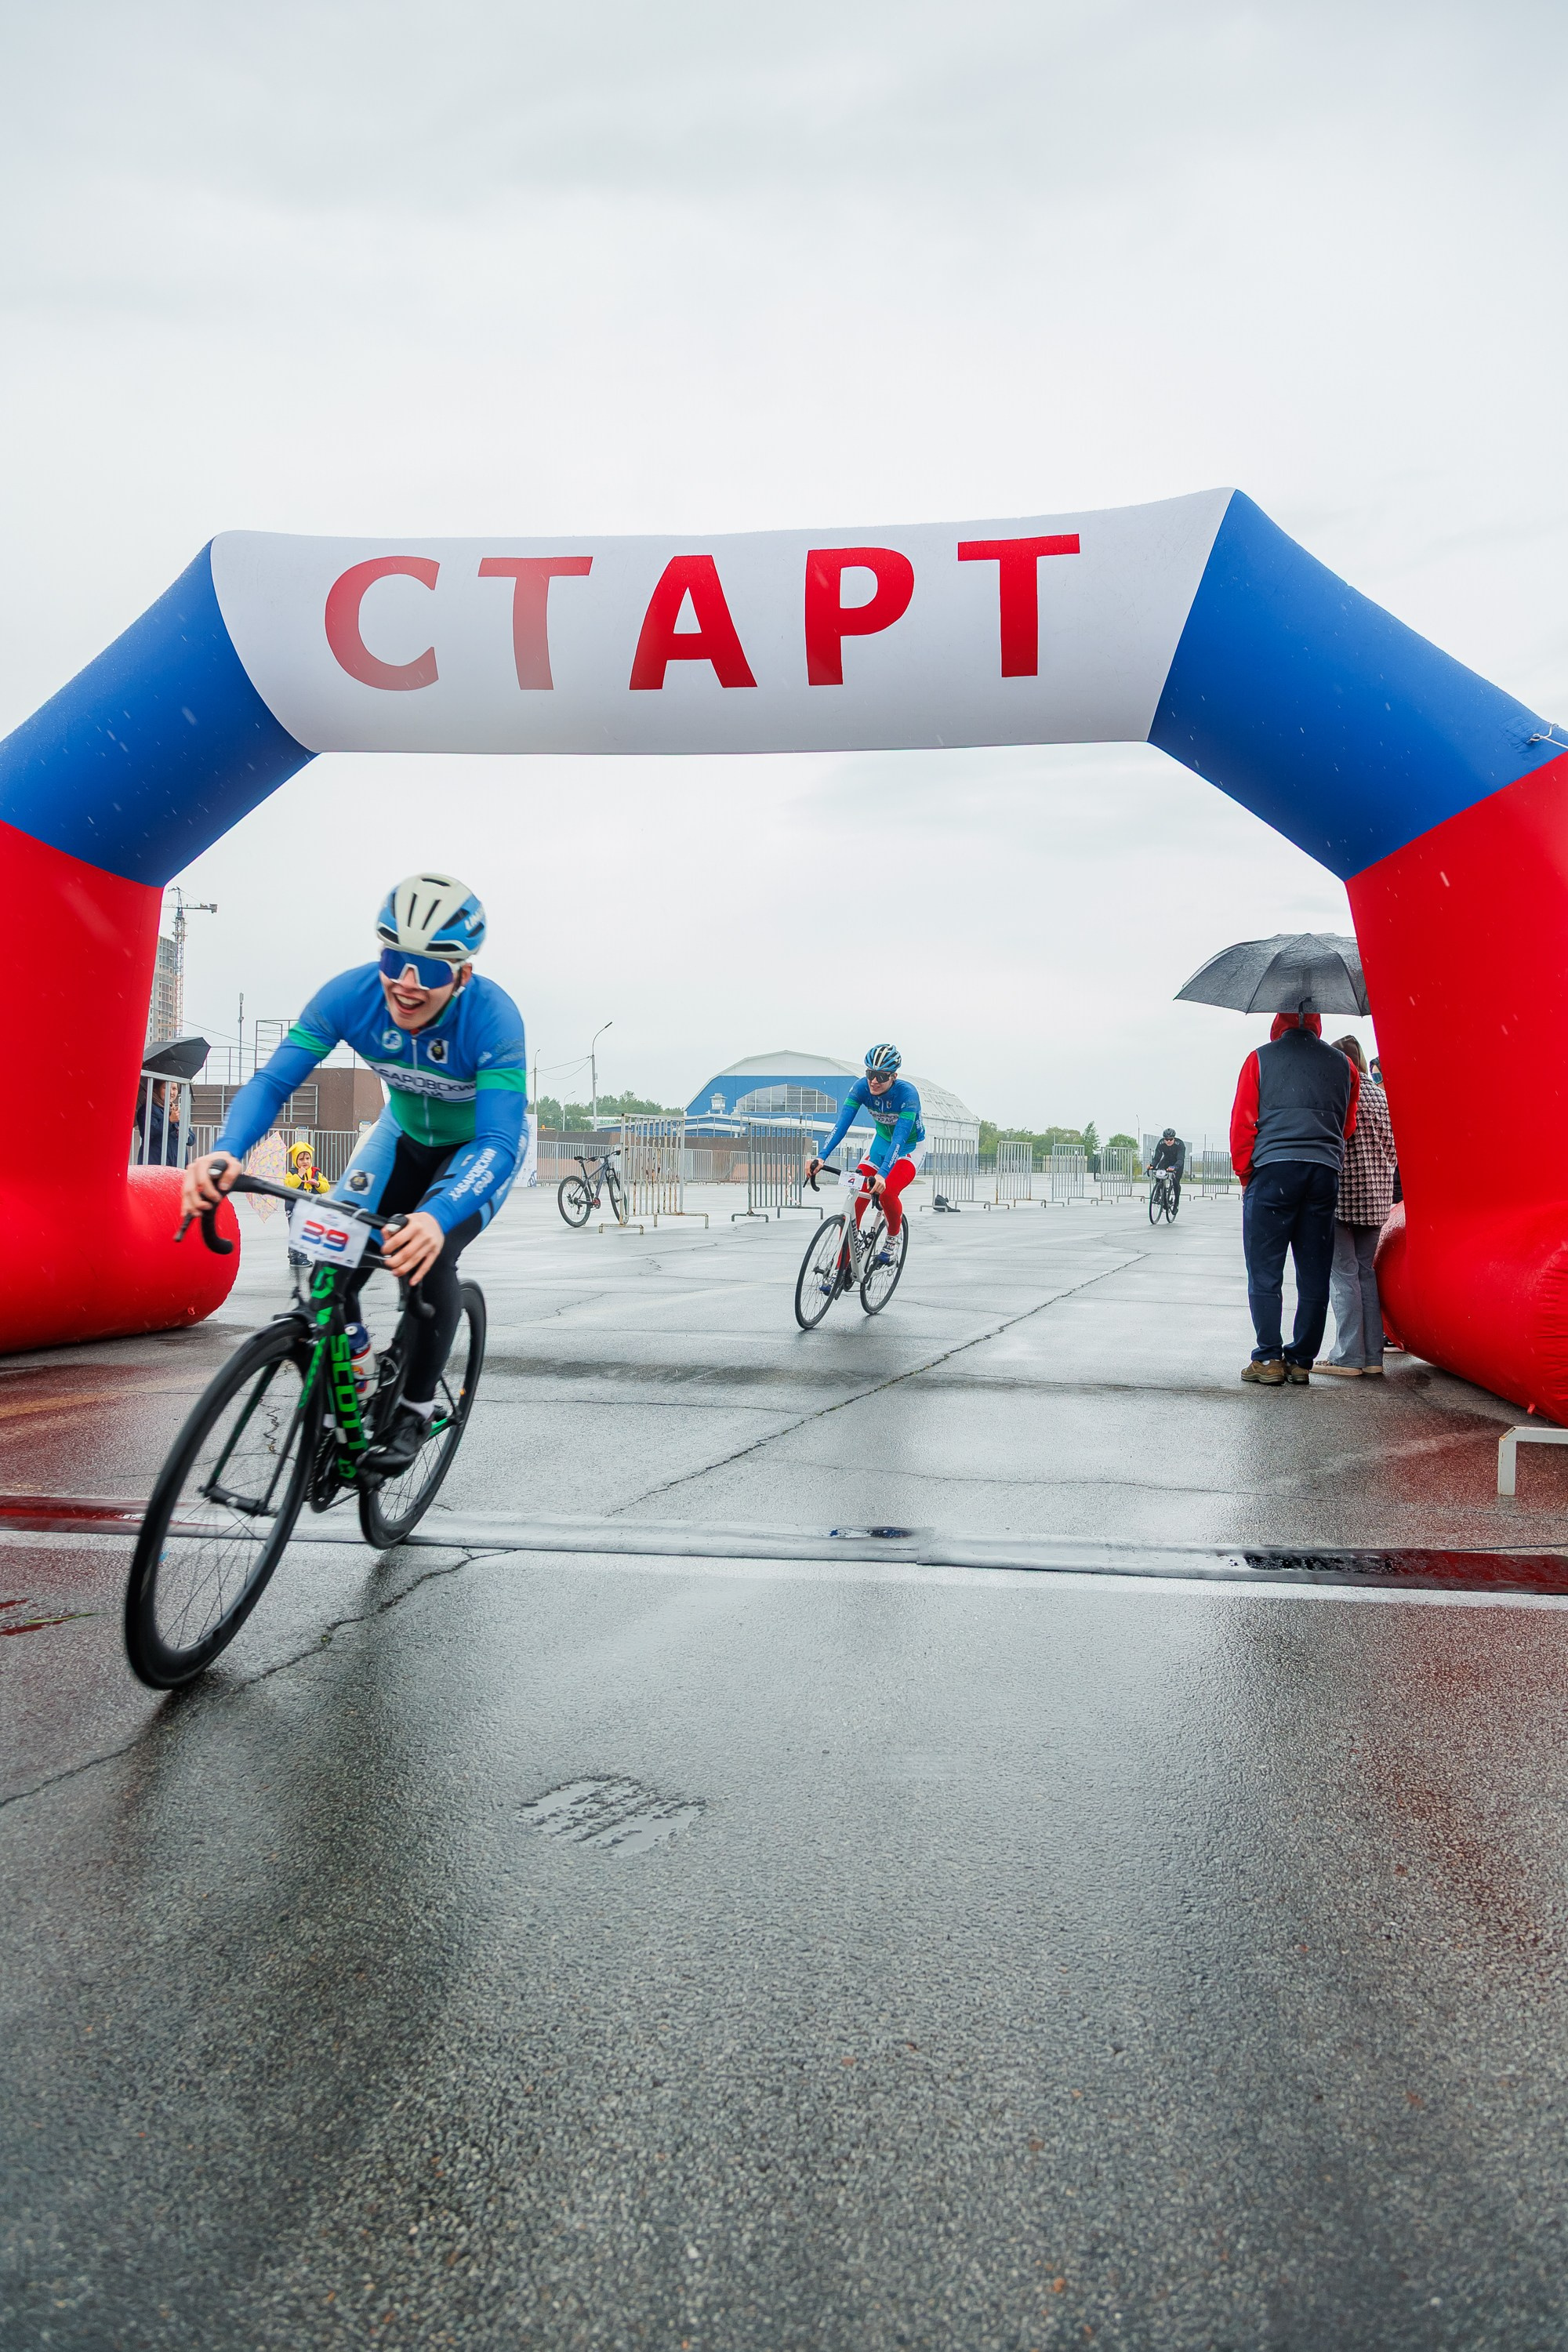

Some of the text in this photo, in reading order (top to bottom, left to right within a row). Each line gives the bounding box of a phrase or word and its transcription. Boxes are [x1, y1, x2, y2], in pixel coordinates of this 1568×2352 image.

[325, 533, 1080, 691] СТАРТ
[300, 1220, 350, 1252] 39
[330, 1334, 368, 1450] SCOTT
